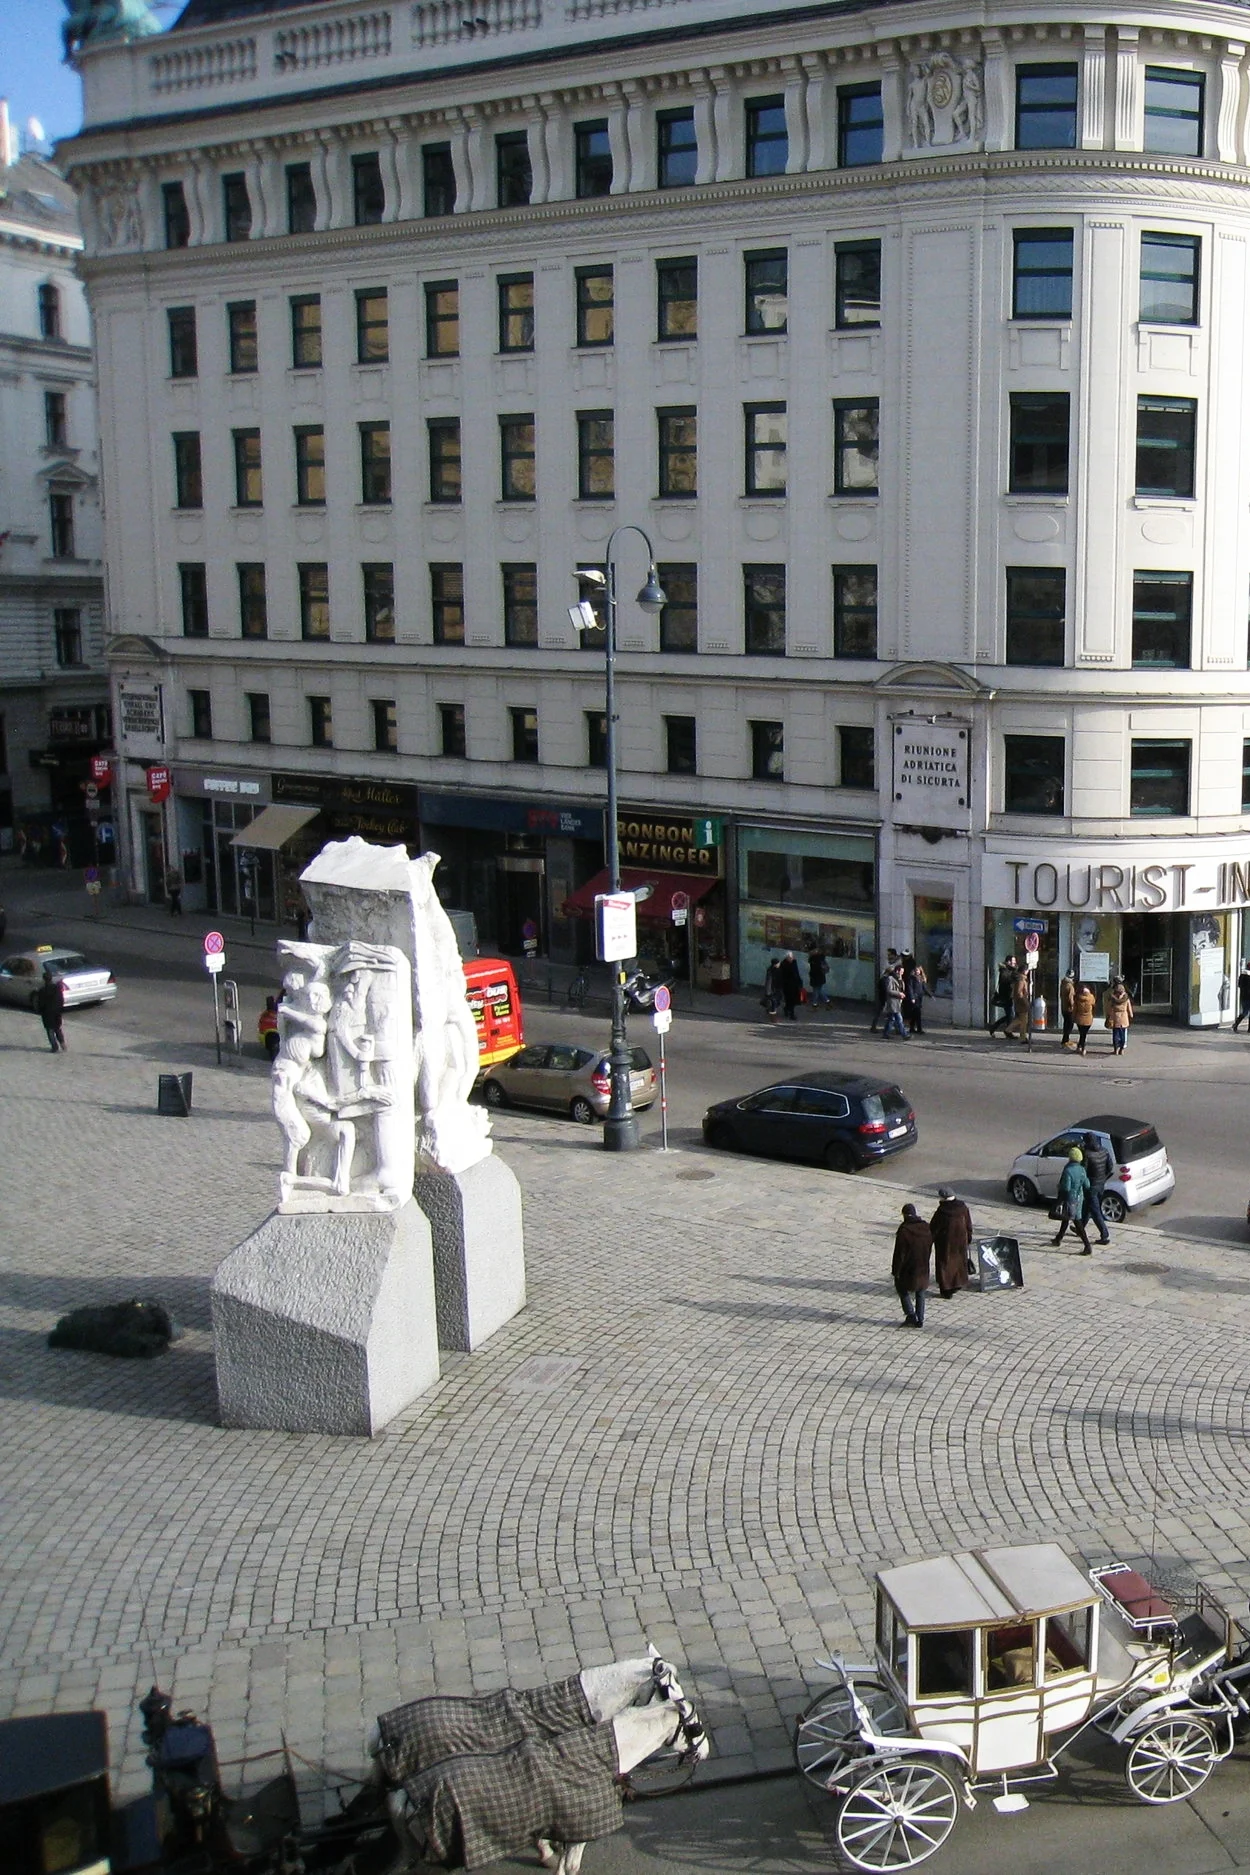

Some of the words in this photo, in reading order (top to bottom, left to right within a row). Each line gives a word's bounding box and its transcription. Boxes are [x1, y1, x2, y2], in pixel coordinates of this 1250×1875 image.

[904, 745, 957, 758] RIUNIONE
[903, 760, 957, 772] ADRIATICA
[901, 774, 912, 783] DI
[916, 775, 961, 788] SICURTA
[617, 820, 693, 842] BONBON
[617, 841, 710, 865] ANZINGER
